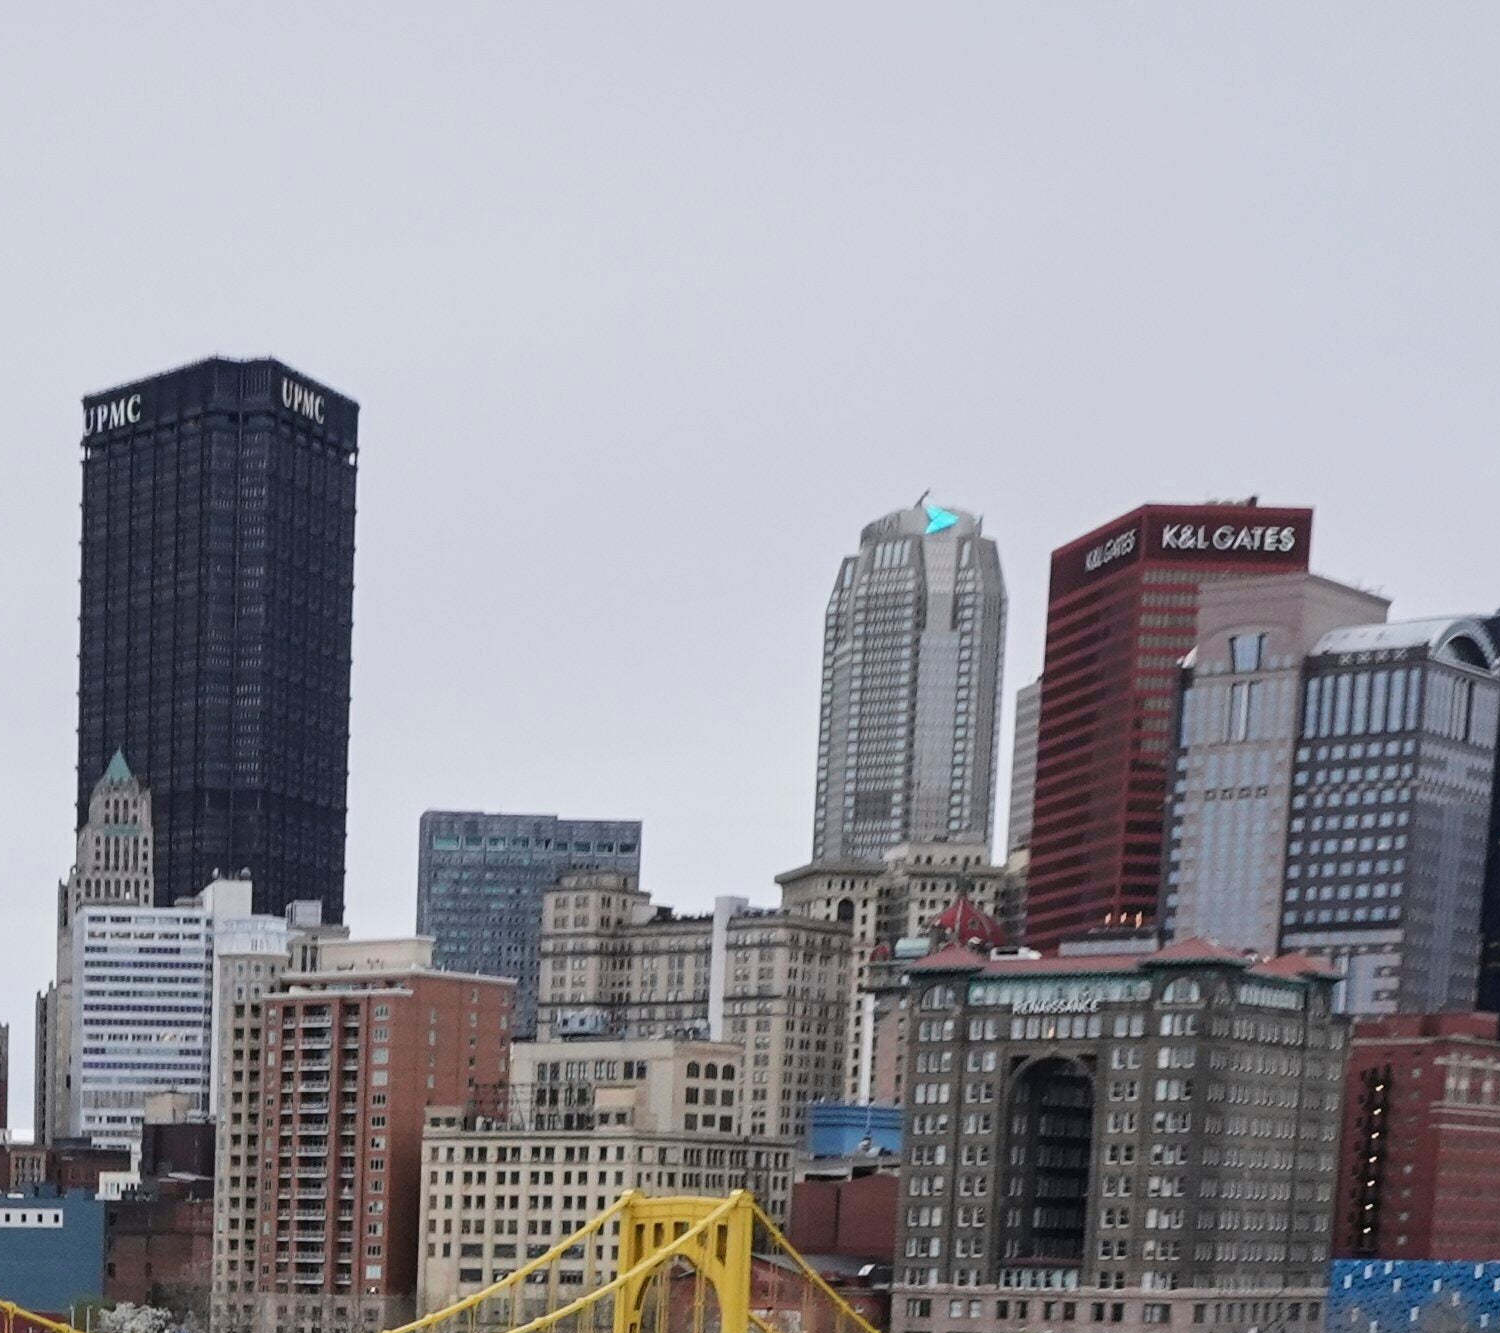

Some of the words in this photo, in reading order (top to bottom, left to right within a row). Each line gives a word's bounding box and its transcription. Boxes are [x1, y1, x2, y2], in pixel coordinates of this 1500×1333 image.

[83, 394, 141, 437] UPMC
[282, 379, 325, 425] UPMC
[1162, 525, 1207, 550] K&L
[1211, 525, 1297, 552] GATES
